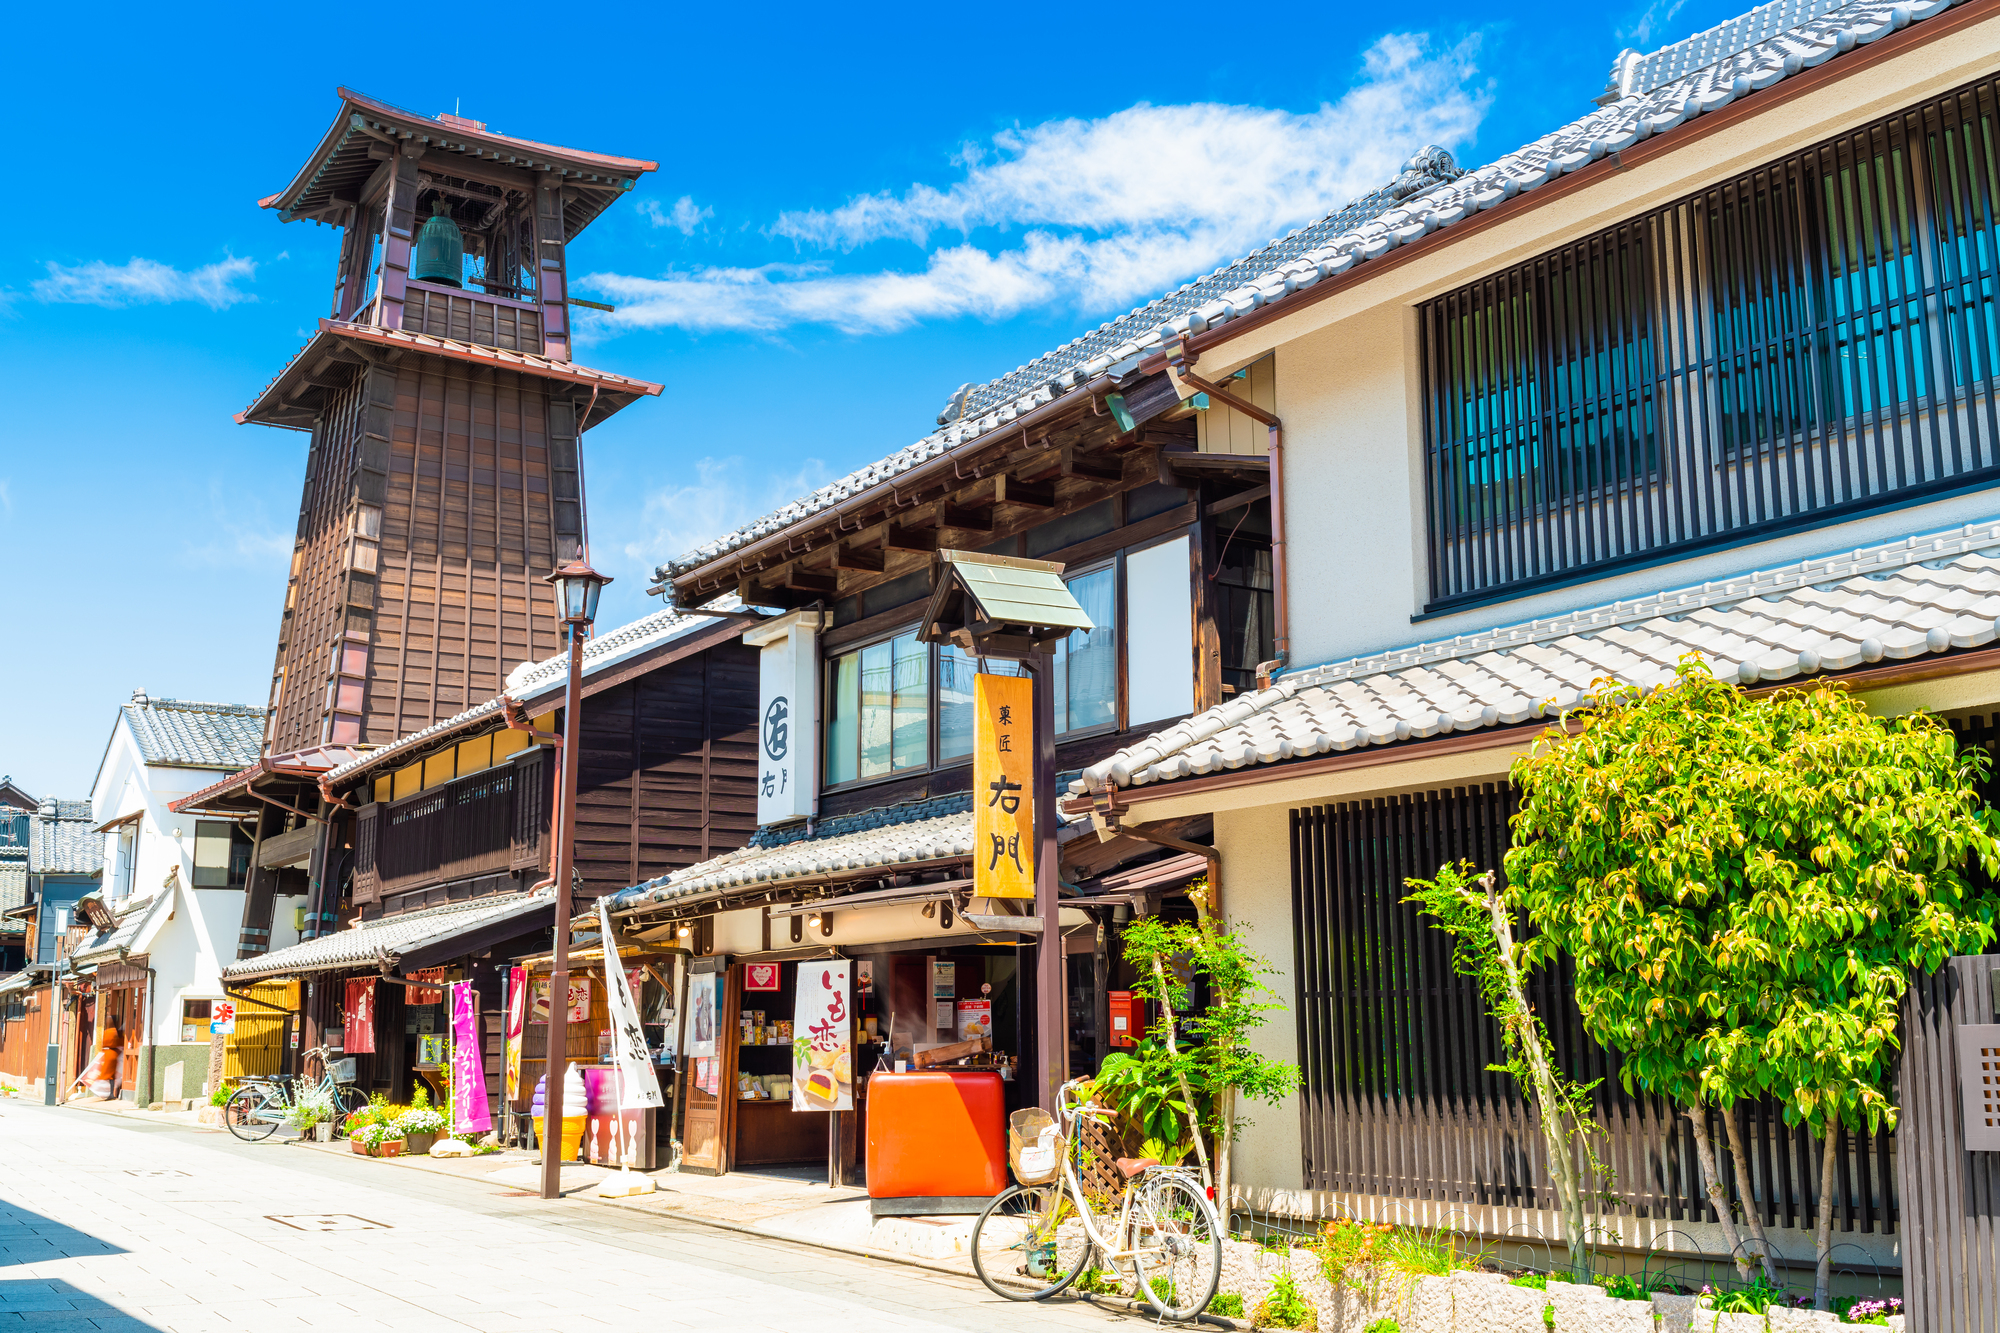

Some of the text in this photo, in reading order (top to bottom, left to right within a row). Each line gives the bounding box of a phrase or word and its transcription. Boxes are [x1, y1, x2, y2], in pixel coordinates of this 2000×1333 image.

[765, 699, 788, 757] 右
[988, 774, 1024, 875] 右門
[213, 1003, 234, 1023] 氷
[533, 981, 551, 989] 川越
[808, 969, 846, 1053] いも恋
[459, 1047, 473, 1129] ソフトクリーム
